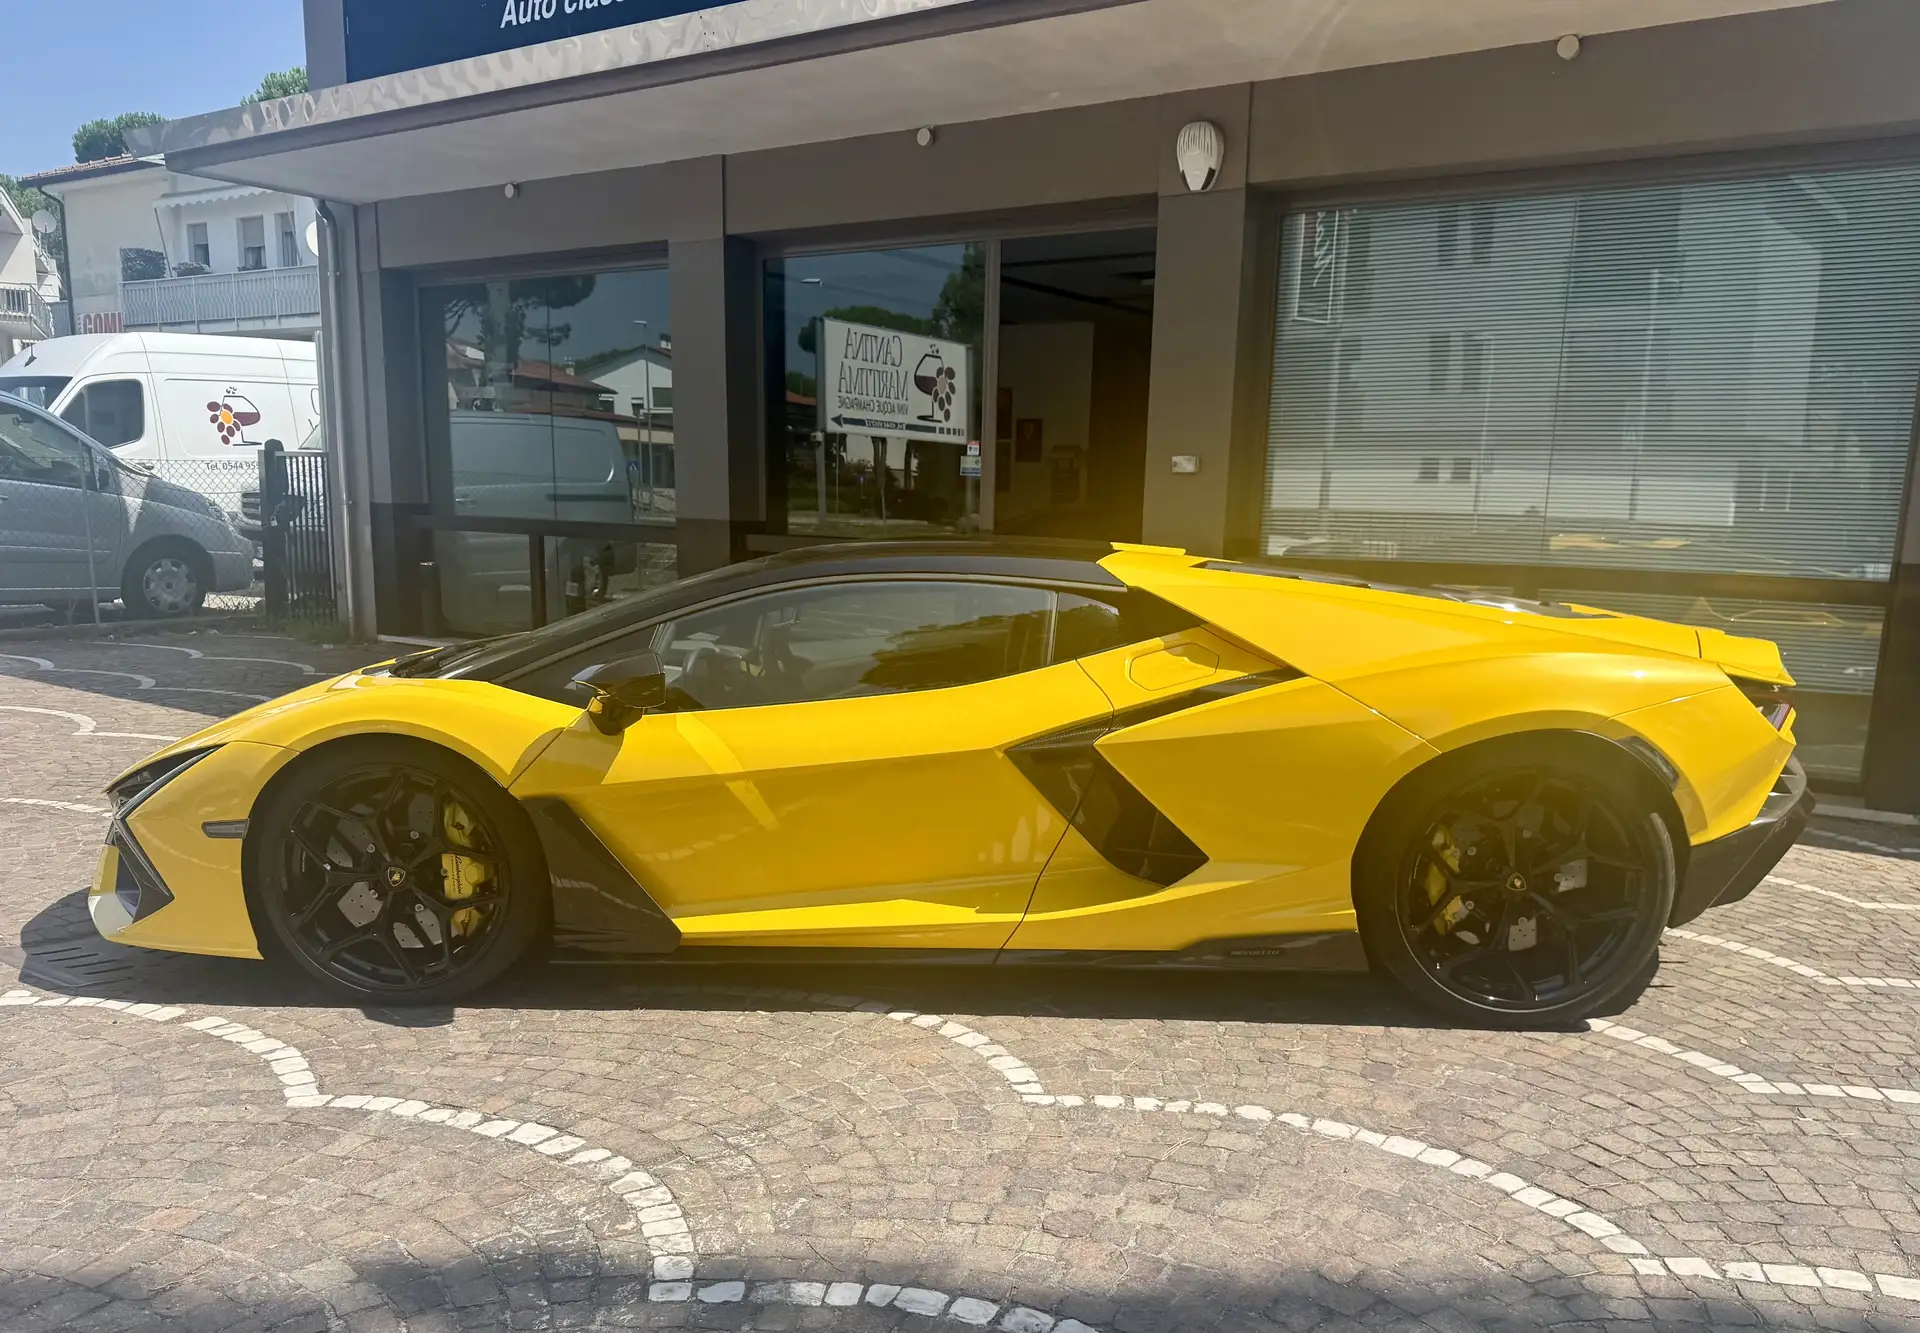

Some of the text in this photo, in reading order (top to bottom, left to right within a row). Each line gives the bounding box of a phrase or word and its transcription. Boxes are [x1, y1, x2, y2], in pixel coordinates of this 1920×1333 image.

[500, 0, 557, 28] Auto
[204, 462, 221, 470] Tel.
[222, 461, 243, 471] 0544
